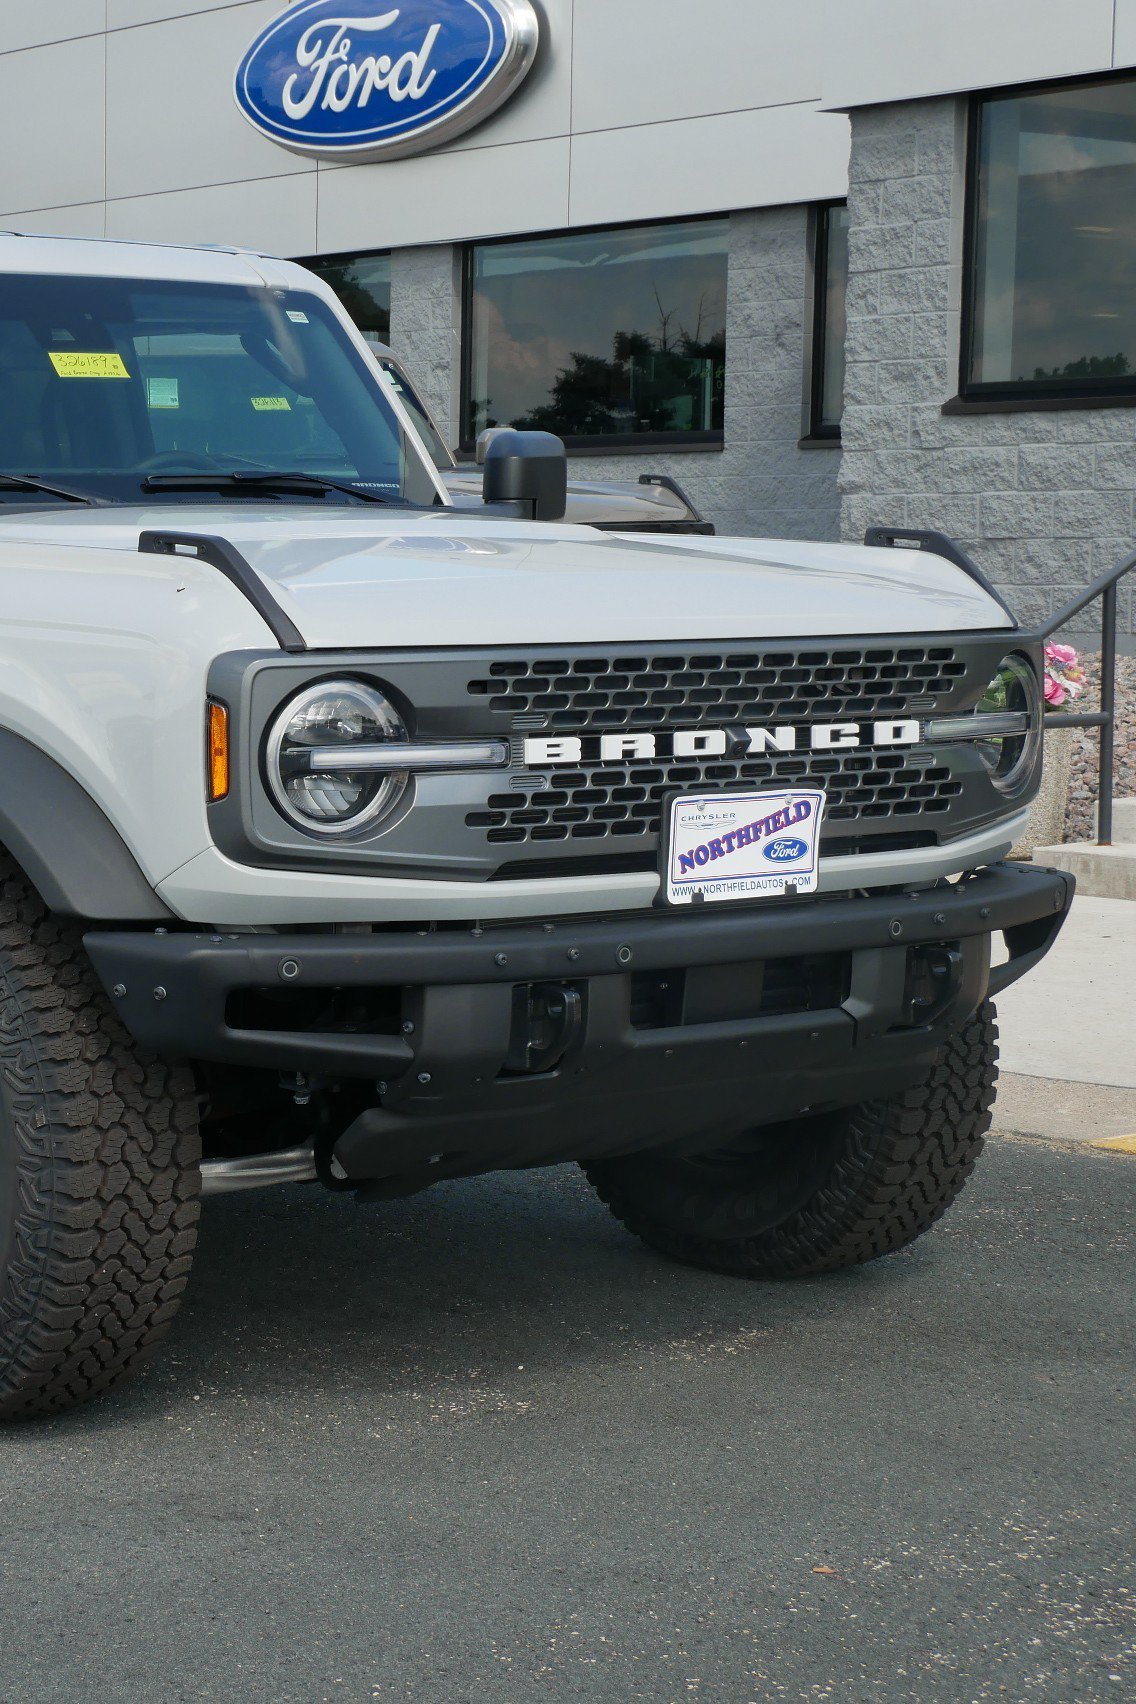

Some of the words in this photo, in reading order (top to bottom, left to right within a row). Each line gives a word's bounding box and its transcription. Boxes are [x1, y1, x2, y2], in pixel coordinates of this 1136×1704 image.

[282, 9, 441, 120] Ford
[524, 719, 920, 765] BRONCO
[677, 800, 812, 875] NORTHFIELD
[681, 812, 736, 822] CHRYSLER
[770, 841, 800, 858] Ford
